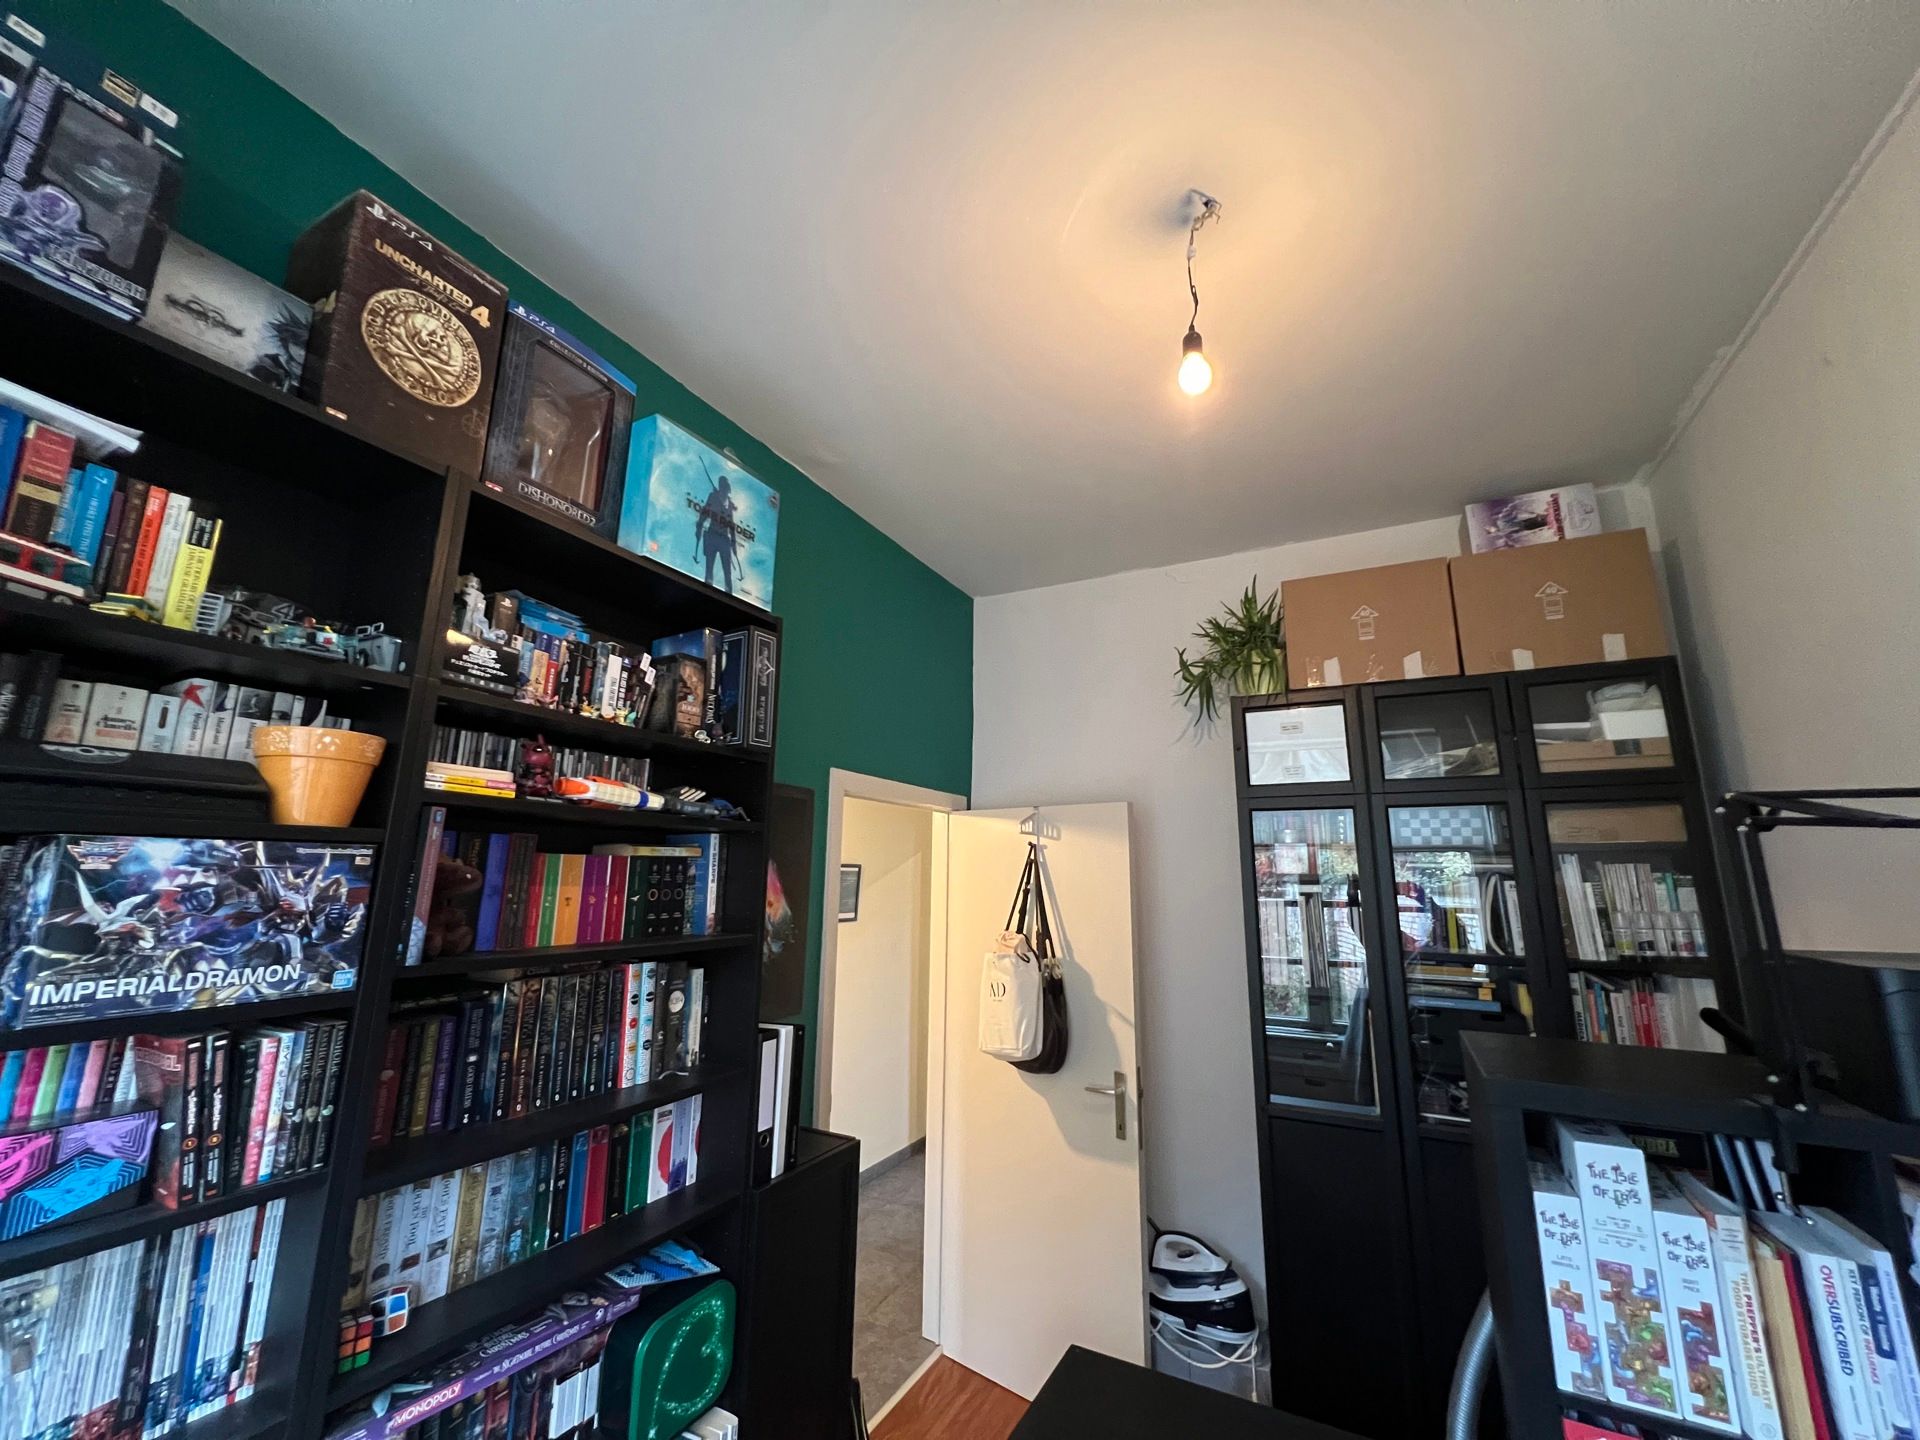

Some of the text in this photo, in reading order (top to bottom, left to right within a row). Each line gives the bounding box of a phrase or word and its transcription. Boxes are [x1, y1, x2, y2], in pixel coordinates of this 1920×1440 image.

[391, 217, 433, 251] PS4
[374, 238, 473, 308] UNCHARTED
[470, 304, 490, 328] 4
[529, 313, 555, 335] PS4
[755, 695, 768, 733] TALISMAN
[212, 716, 224, 745] Murakami
[29, 963, 302, 1006] IMPERIALDRAMON
[462, 1064, 476, 1109] GOOD OMENS
[497, 1078, 506, 1106] RIORDAN
[516, 1074, 525, 1102] RIORDAN
[557, 1145, 567, 1175] HARRIS
[1586, 1161, 1640, 1185] THE ISLE
[1592, 1185, 1609, 1199] OF
[436, 1179, 451, 1236] OOL'S FATE
[1539, 1210, 1581, 1229] THE ISLE
[406, 1222, 418, 1247] FOOL
[1544, 1228, 1557, 1239] OF
[1661, 1231, 1683, 1247] THE
[1683, 1233, 1708, 1251] ISLE
[1667, 1251, 1682, 1263] OF
[1851, 1287, 1867, 1323] PERSON
[1819, 1264, 1854, 1377] OVERSUBSCRIBED
[1859, 1322, 1870, 1338] OF
[1731, 1280, 1760, 1397] FOOD STORAGE GUIDE
[1739, 1272, 1774, 1410] THE PREPPER'S ULTIMATE
[1862, 1337, 1881, 1385] INFLUENCE
[393, 1383, 462, 1427] MONOPOLY
